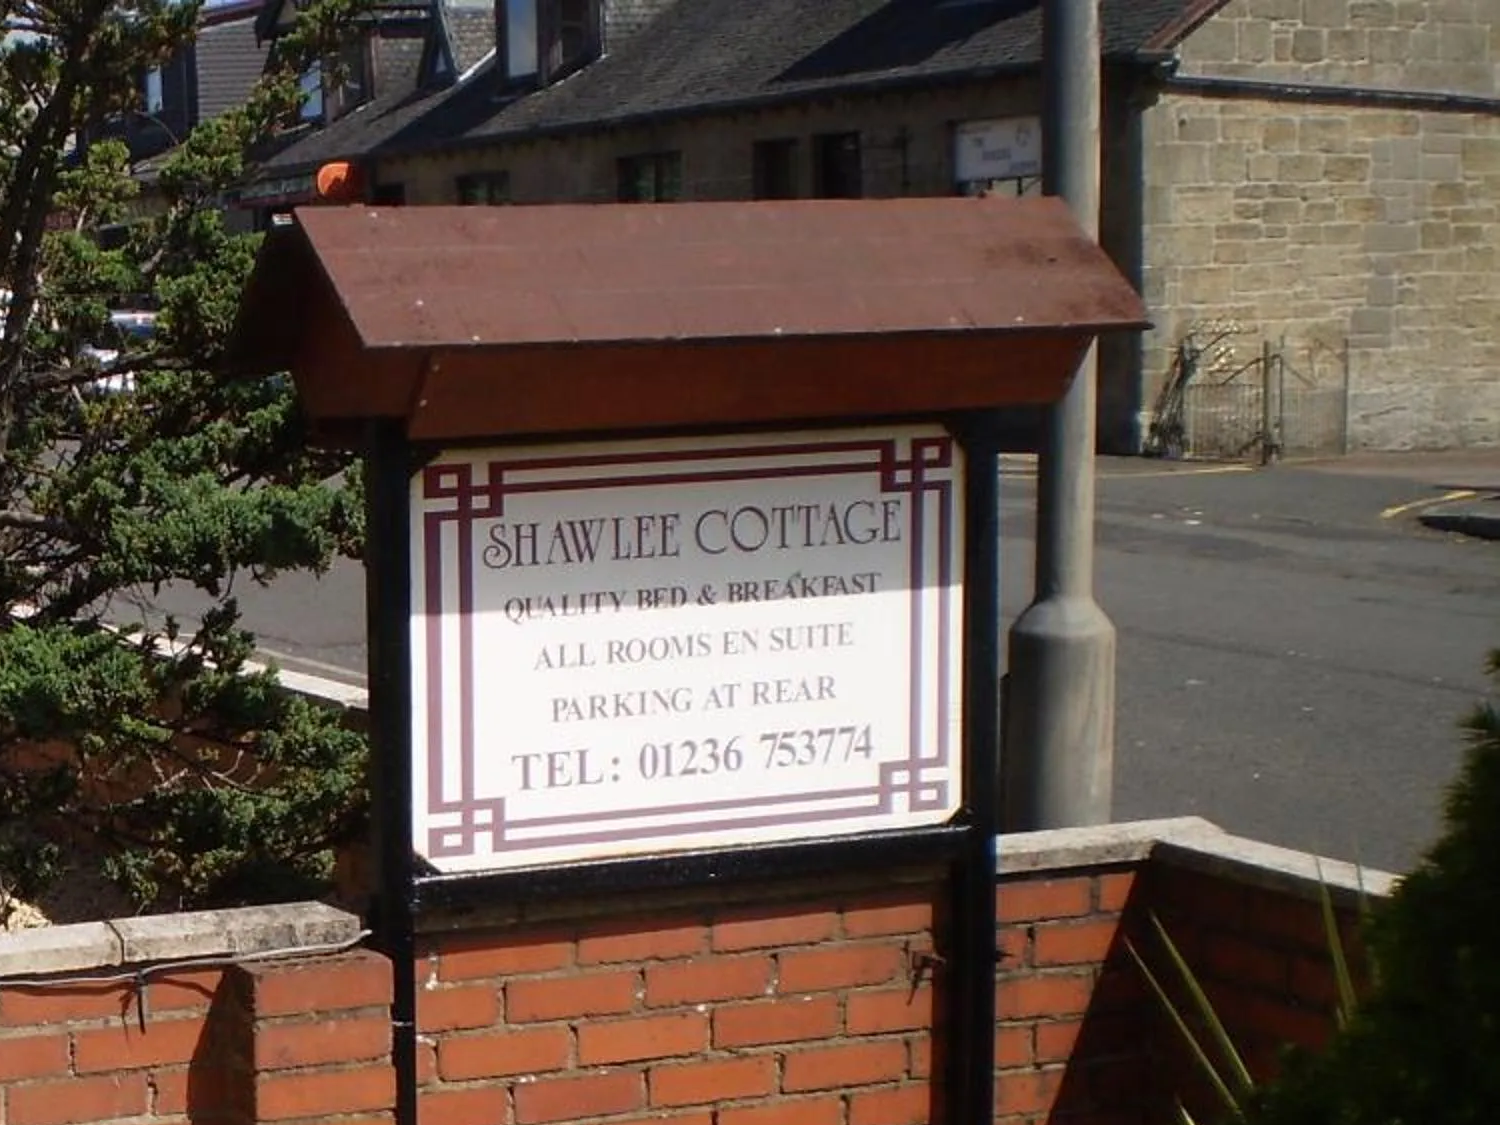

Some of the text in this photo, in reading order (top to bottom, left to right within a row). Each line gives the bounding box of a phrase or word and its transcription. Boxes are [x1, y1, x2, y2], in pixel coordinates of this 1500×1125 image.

[482, 499, 902, 570] SHAWLEE COTTAGE
[504, 571, 882, 624] QUALITY BED & BREAKFAST
[533, 621, 854, 672] ALL ROOMS EN SUITE
[551, 675, 837, 723] PARKING AT REAR
[511, 723, 875, 792] TEL: 01236 753774
